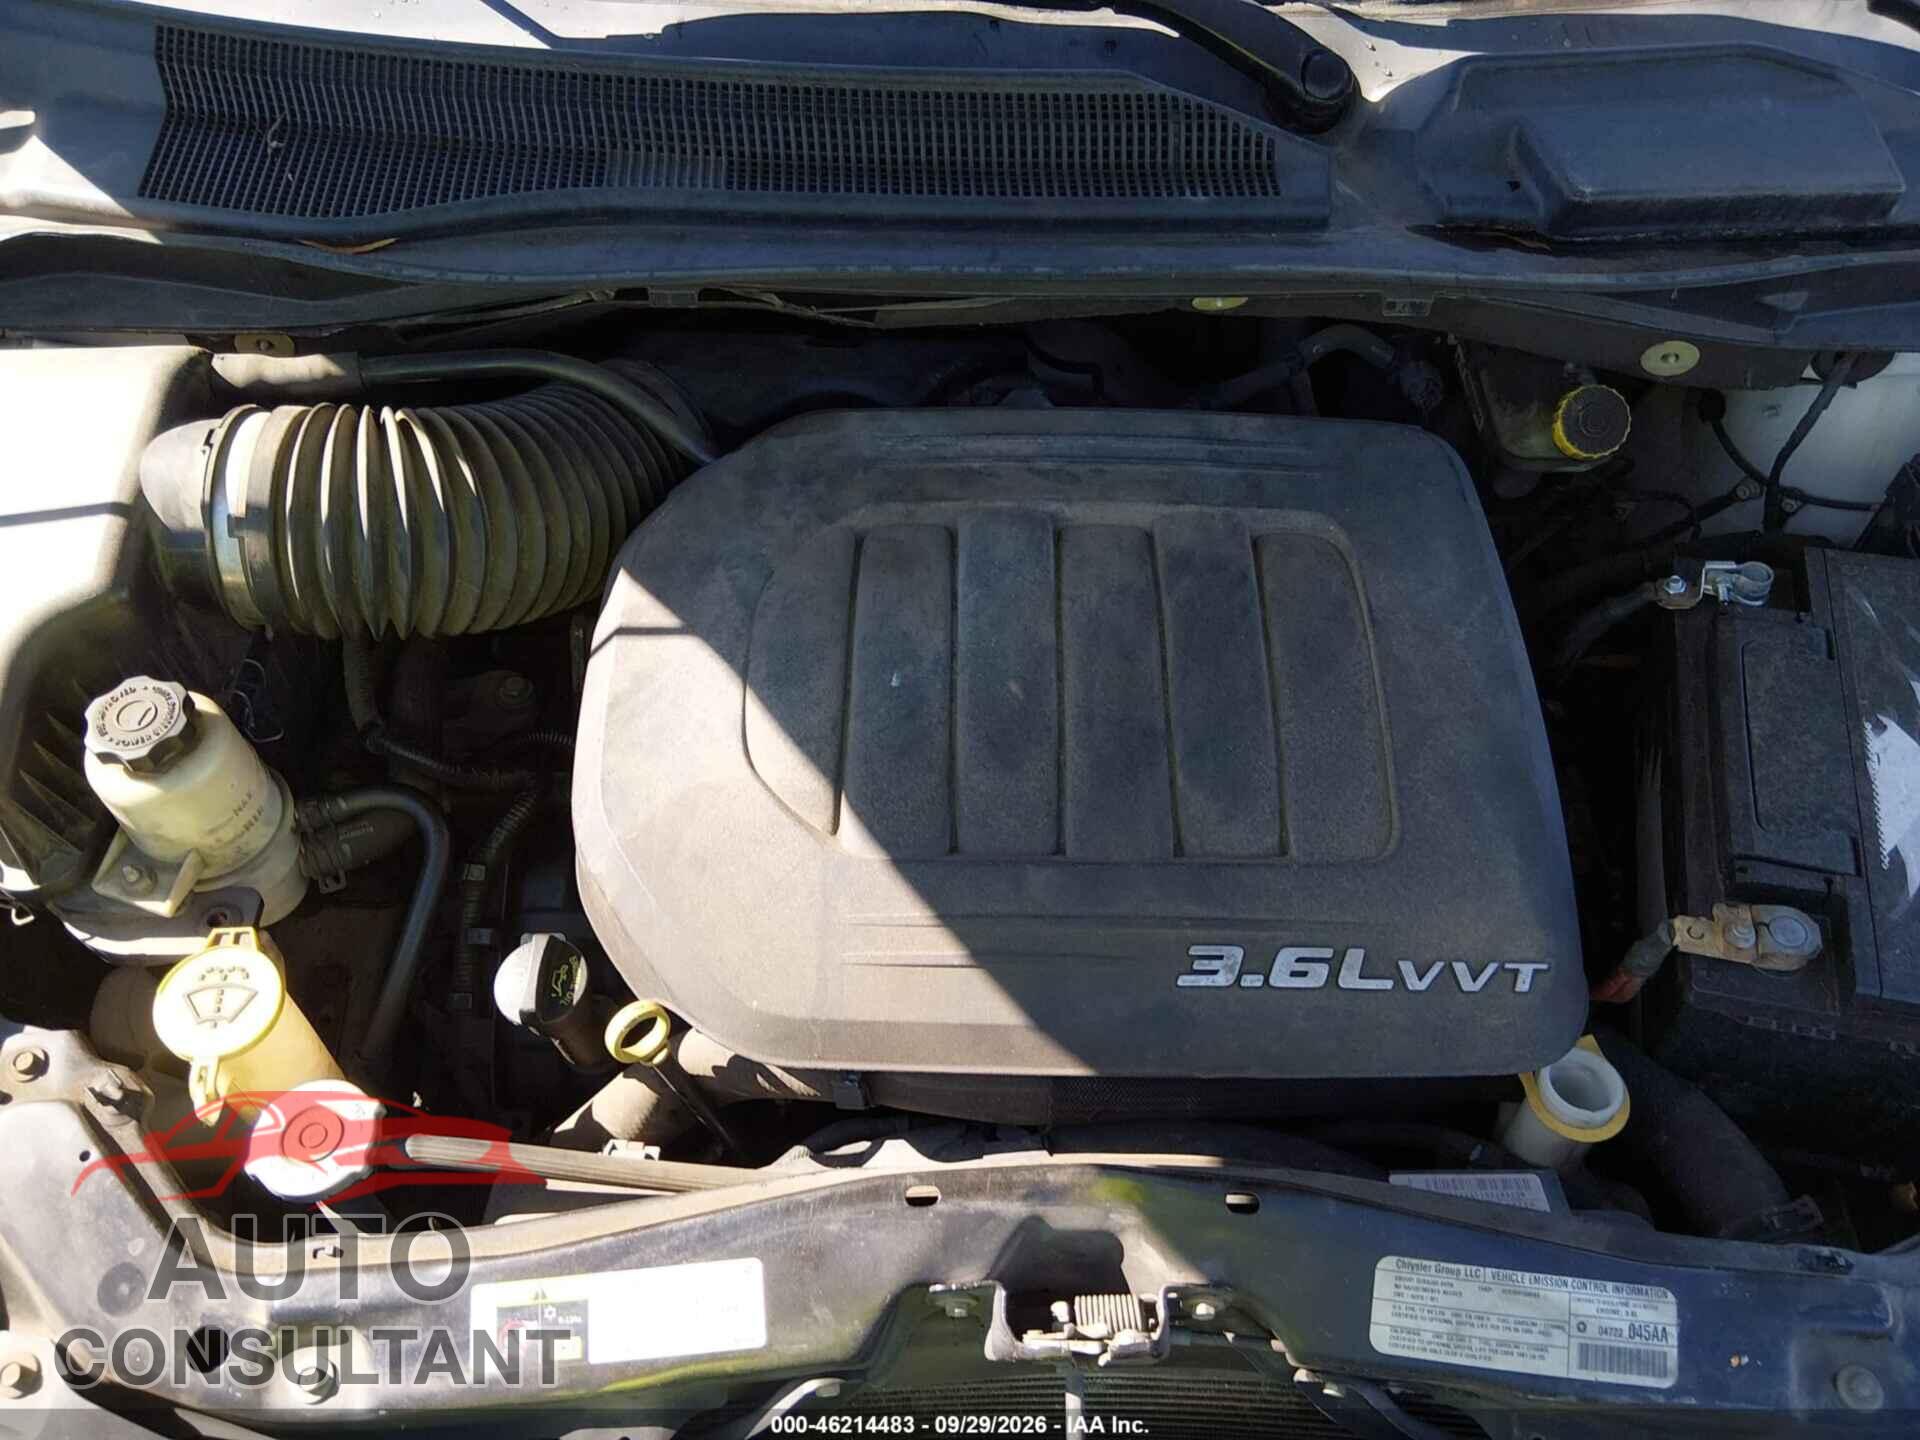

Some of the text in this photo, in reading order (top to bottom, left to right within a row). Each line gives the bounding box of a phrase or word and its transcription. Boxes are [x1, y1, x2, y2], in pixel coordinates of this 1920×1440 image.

[1434, 1263, 1461, 1277] Group
[1464, 1267, 1481, 1278] LLC
[1491, 1270, 1526, 1283] VEHICLE
[1528, 1274, 1568, 1288] EMISSION
[1571, 1279, 1609, 1293] CONTROL
[1612, 1284, 1668, 1299] INFORMATION
[1628, 1322, 1668, 1343] 045AA
